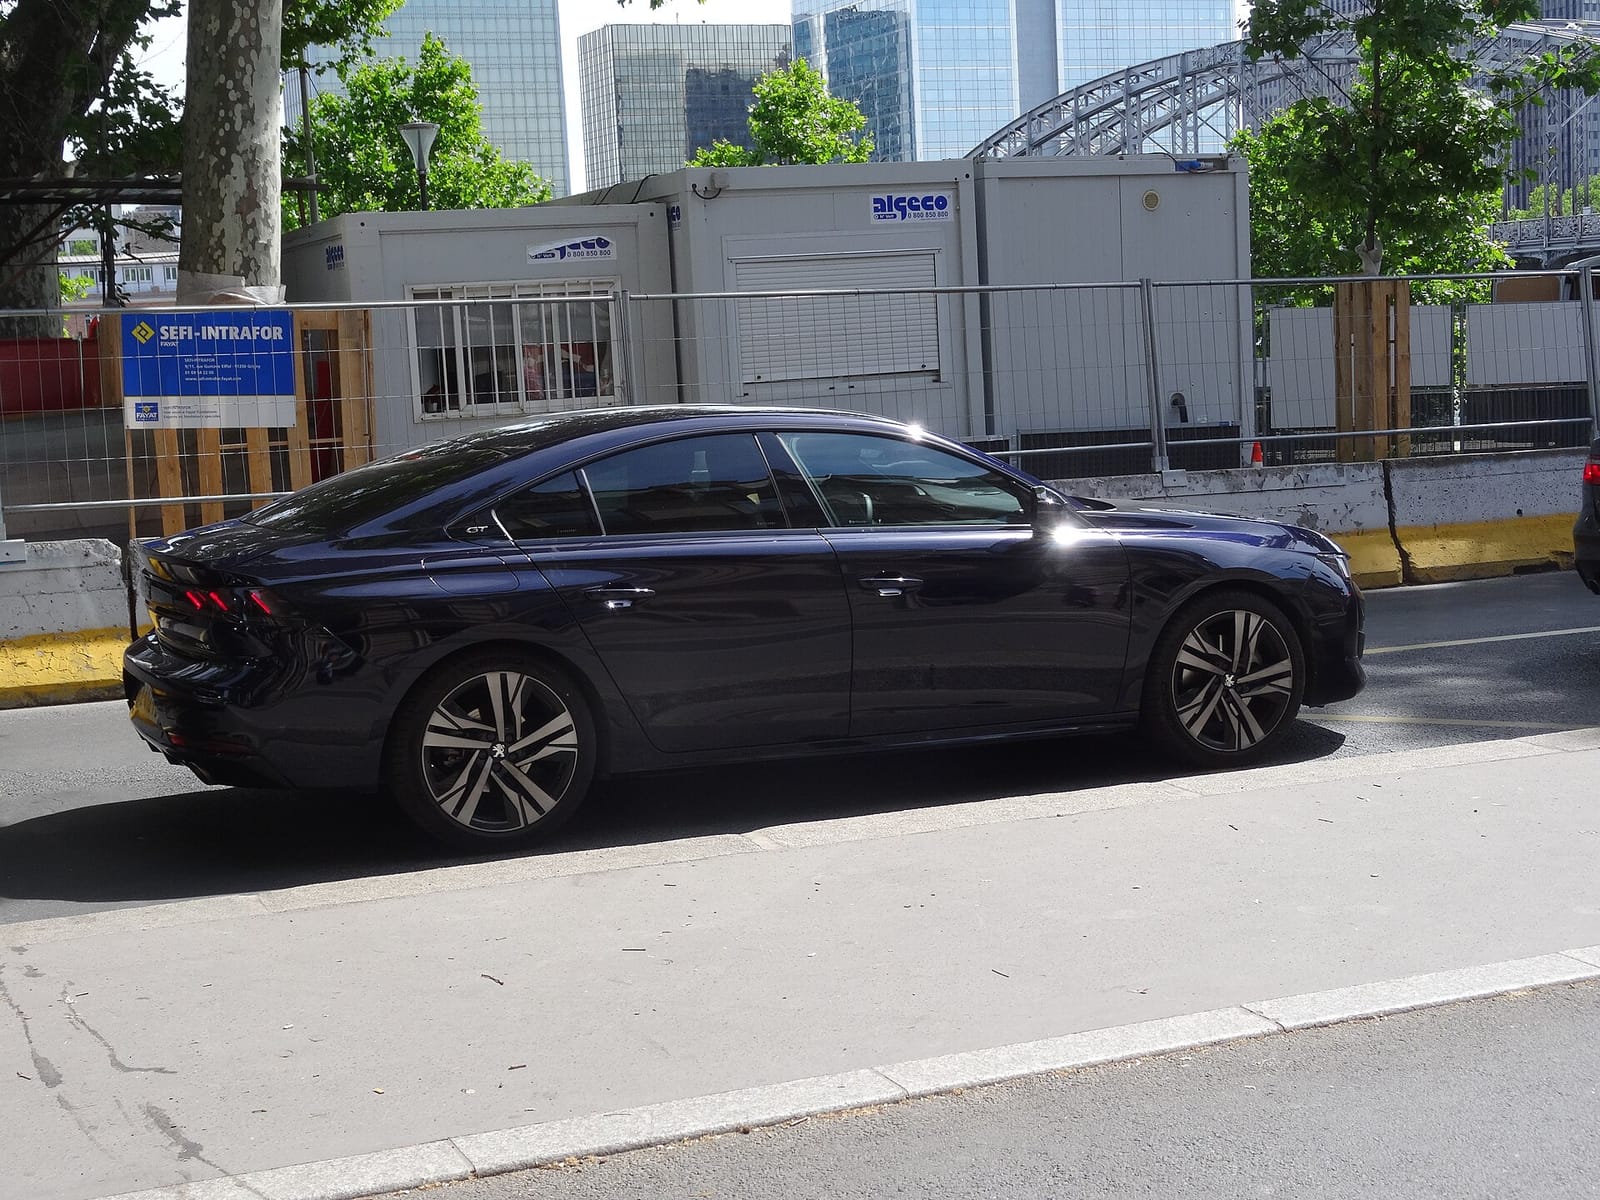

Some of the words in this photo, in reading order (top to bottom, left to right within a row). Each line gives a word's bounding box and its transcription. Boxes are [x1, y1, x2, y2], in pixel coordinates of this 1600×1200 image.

[873, 195, 948, 221] algeco
[159, 325, 283, 340] SEFI-INTRAFOR
[465, 525, 489, 534] GT
